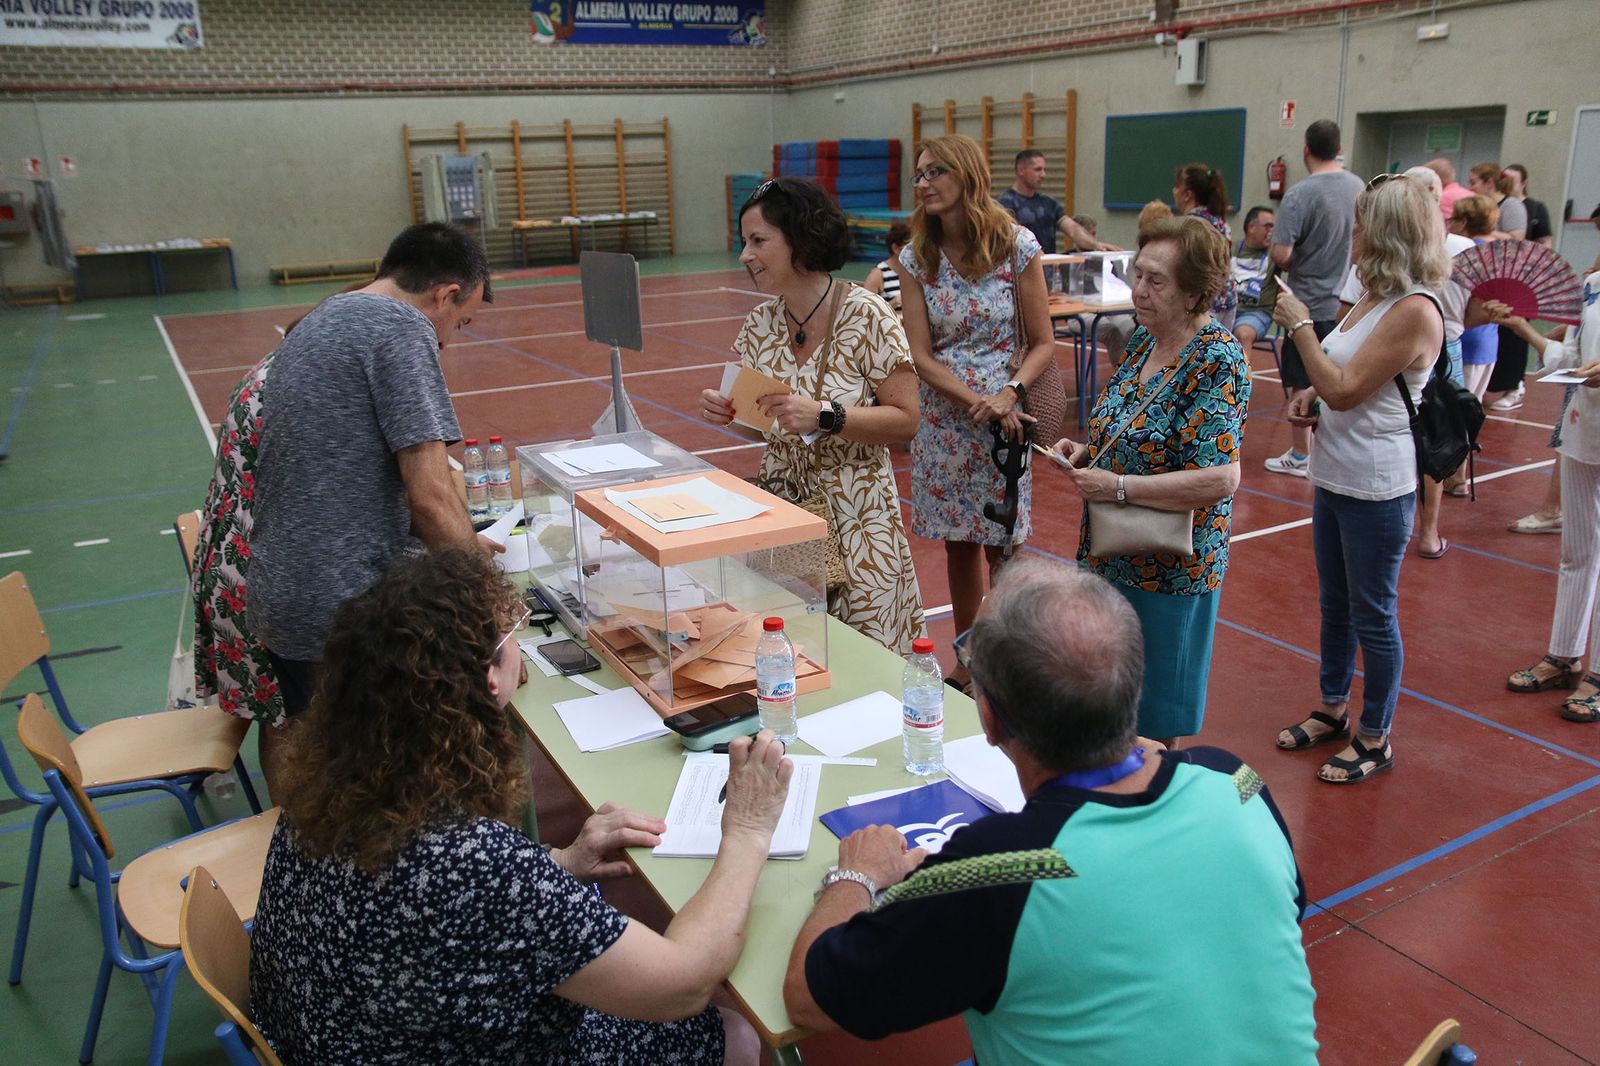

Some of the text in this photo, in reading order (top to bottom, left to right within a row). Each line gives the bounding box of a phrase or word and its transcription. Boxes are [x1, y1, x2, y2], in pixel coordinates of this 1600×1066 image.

[31, 0, 92, 15] VOLLEY
[99, 0, 154, 18] GRUPO
[160, 2, 194, 19] 2008
[629, 3, 671, 20] VOLLEY
[673, 5, 711, 22] GRUPO
[713, 6, 738, 22] 2008
